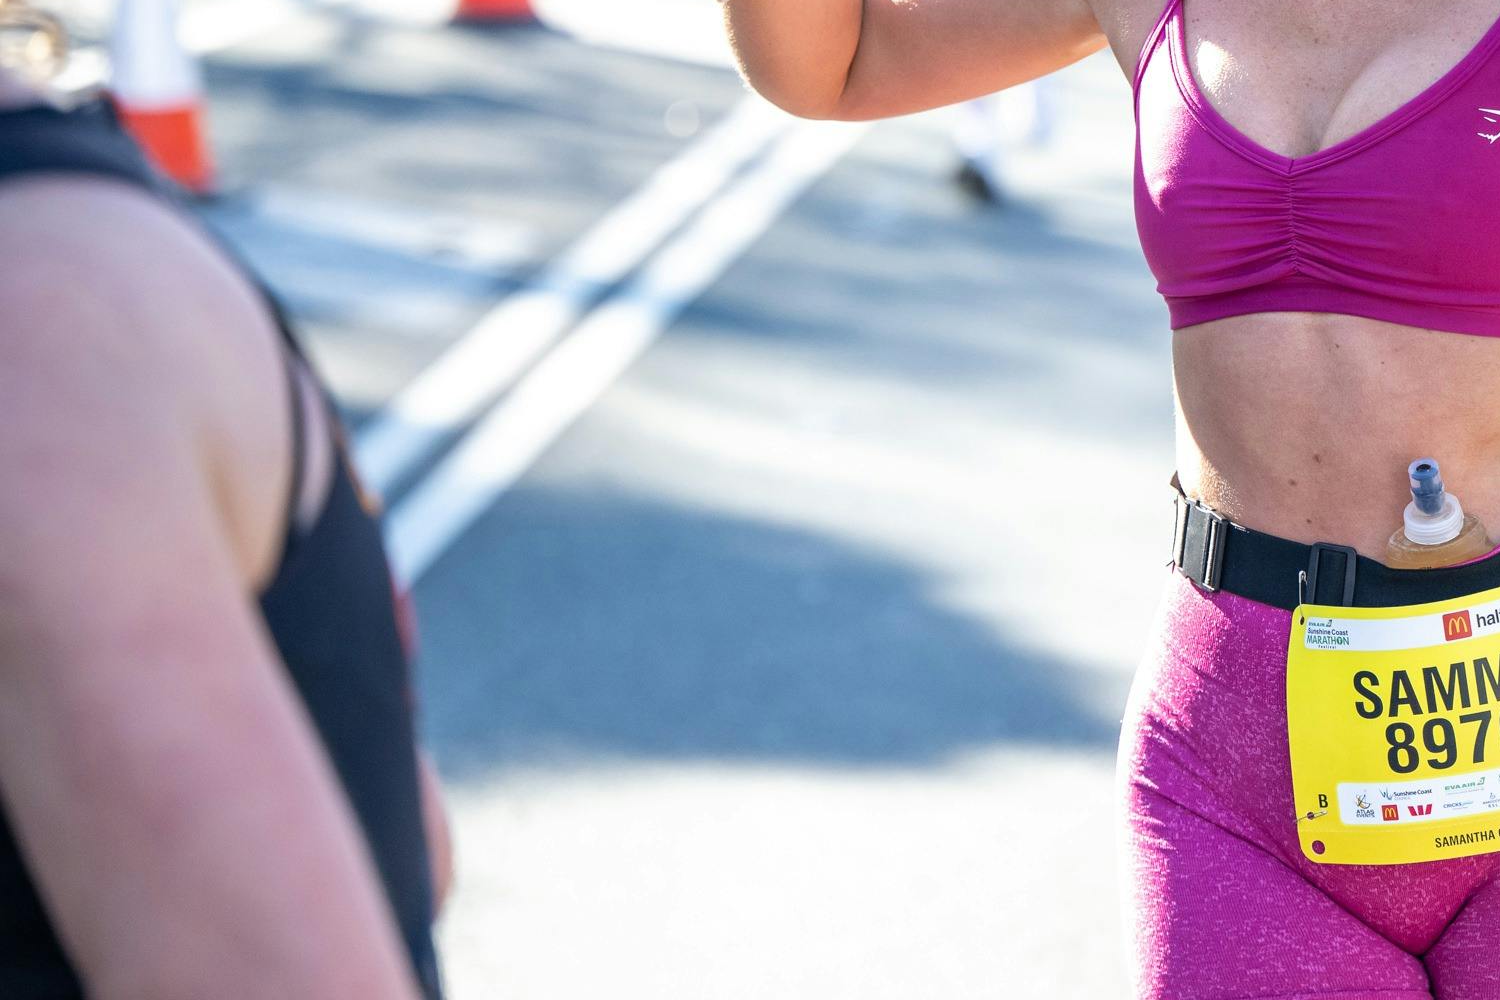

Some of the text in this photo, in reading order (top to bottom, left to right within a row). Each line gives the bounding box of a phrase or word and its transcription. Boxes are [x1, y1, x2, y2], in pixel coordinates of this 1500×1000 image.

[1306, 635, 1350, 645] MARATHON
[1318, 794, 1329, 808] B
[1434, 829, 1495, 849] SAMANTHA
